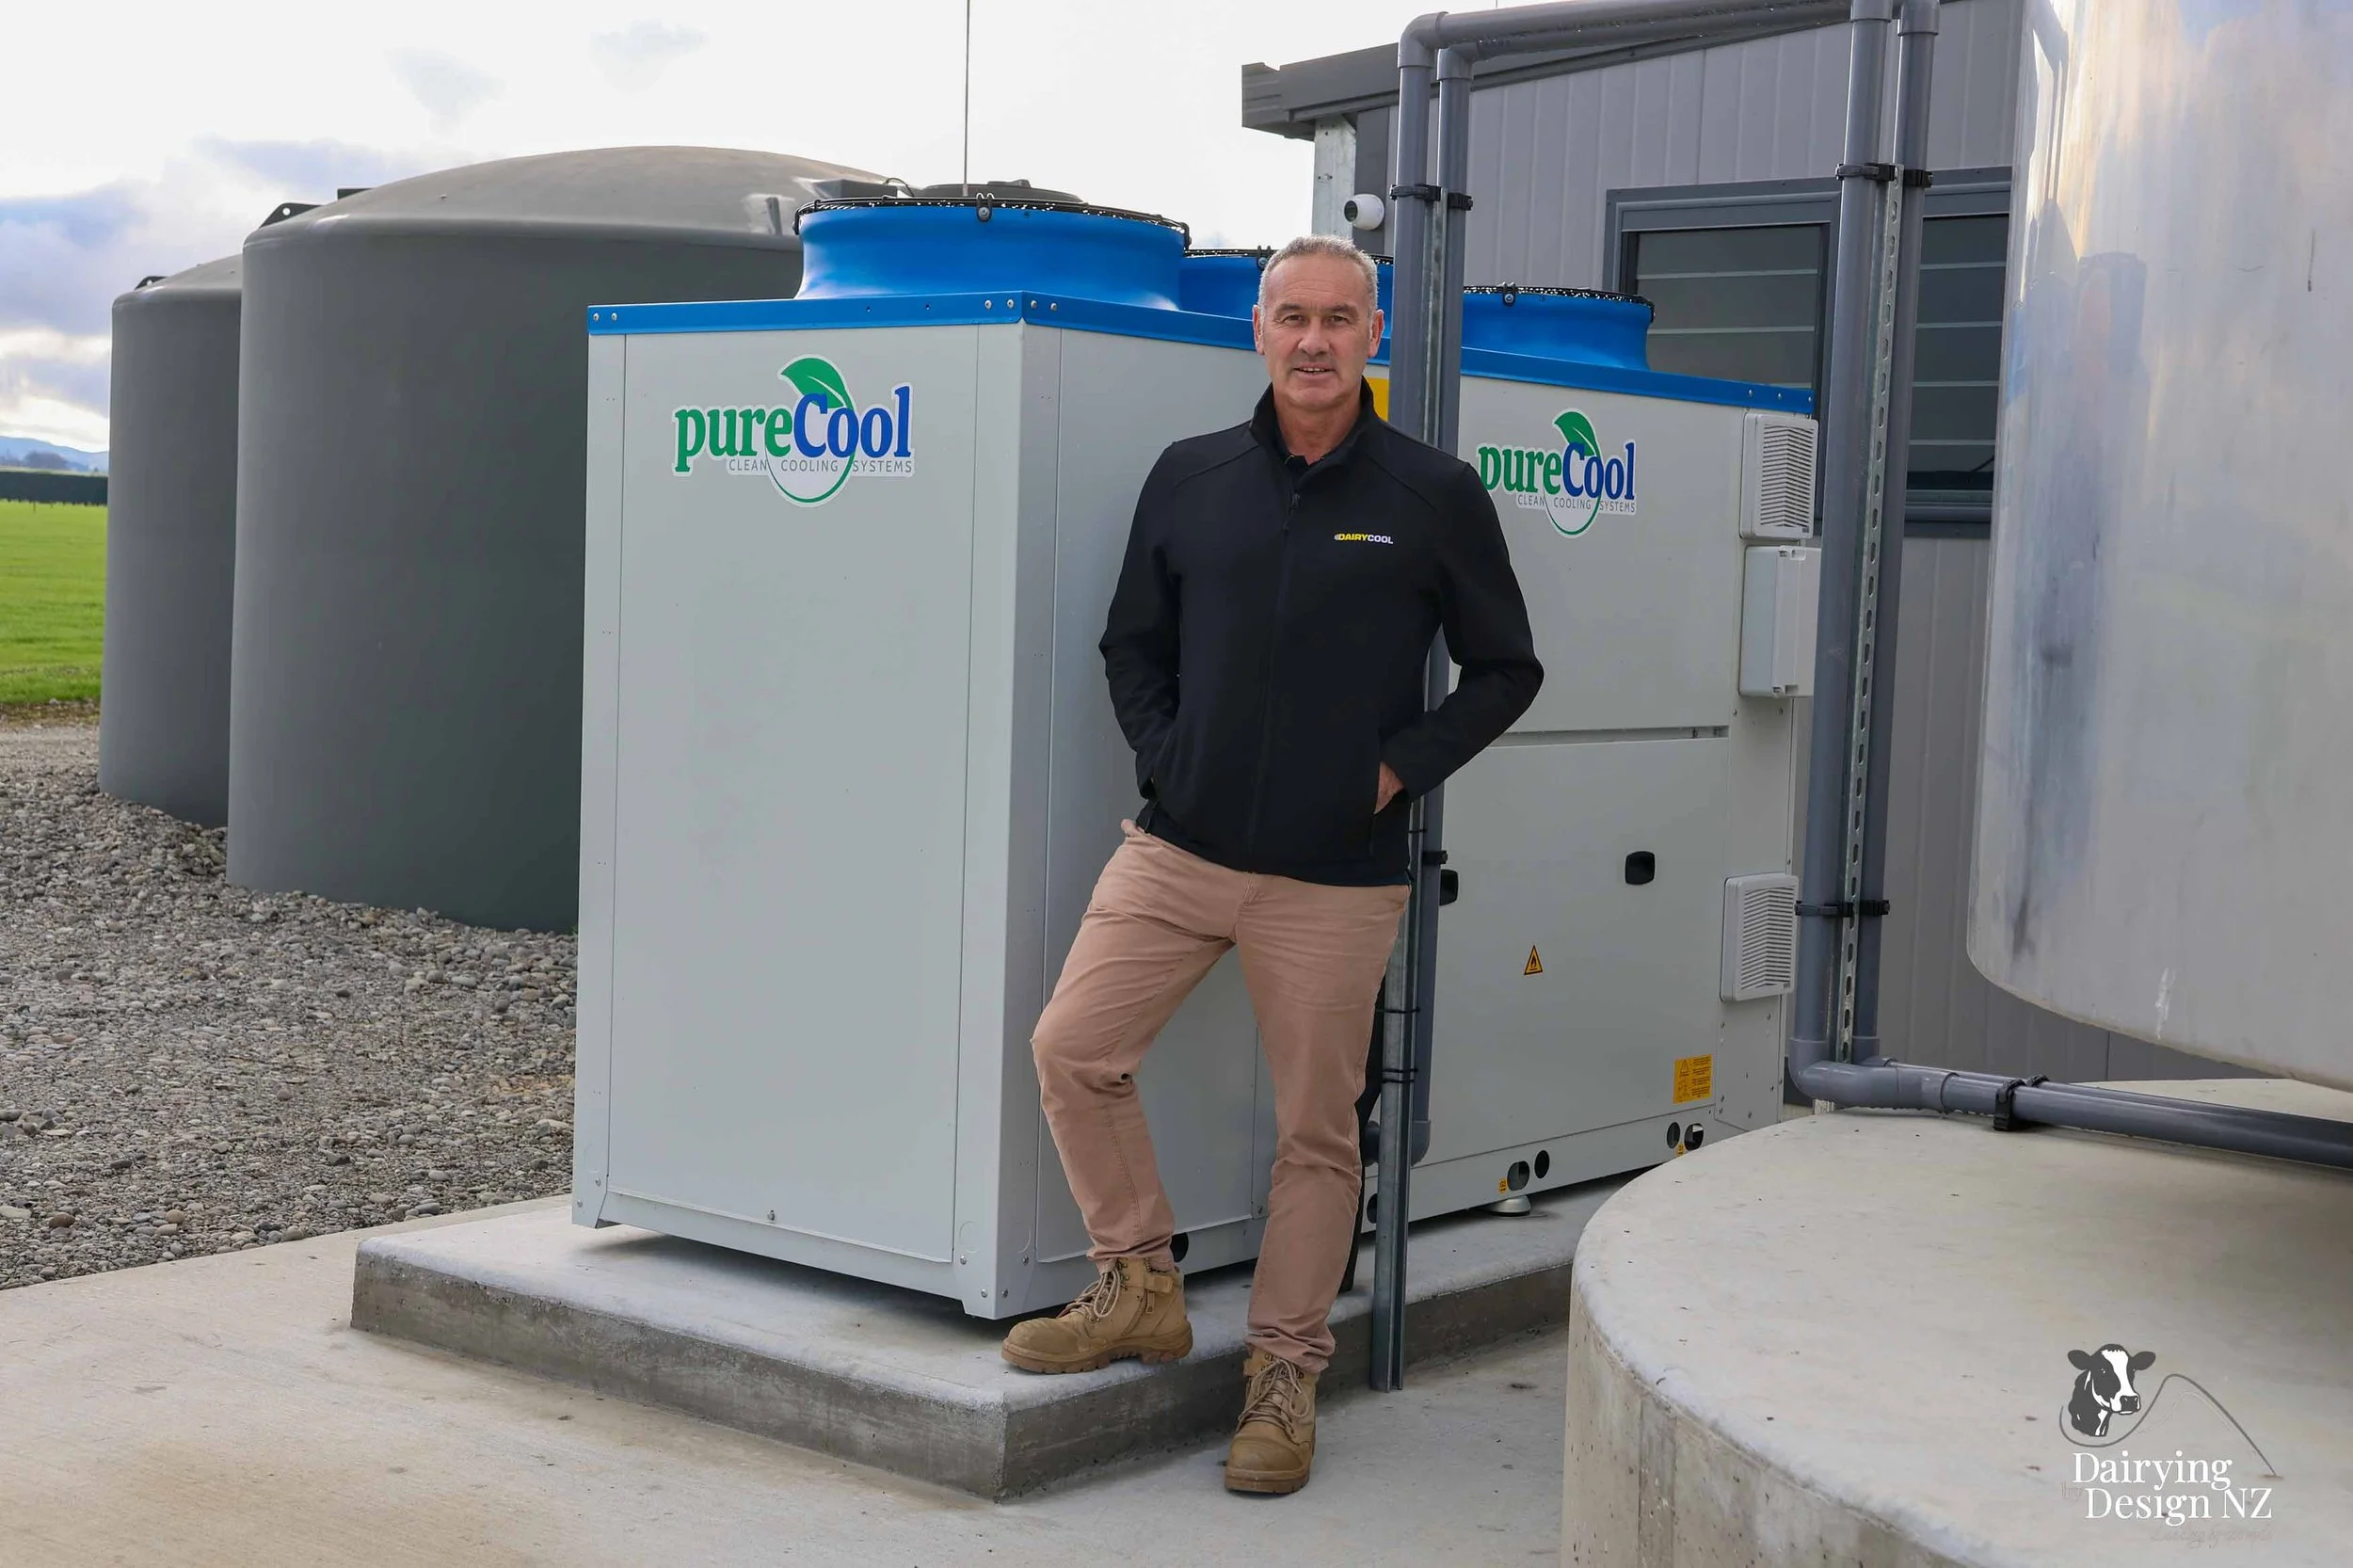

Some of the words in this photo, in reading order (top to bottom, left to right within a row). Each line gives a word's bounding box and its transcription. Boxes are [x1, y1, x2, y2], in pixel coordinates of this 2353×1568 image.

[675, 385, 912, 472] pureCool
[728, 458, 767, 472] CLEAN
[780, 459, 839, 472] COOLING
[852, 459, 912, 472] SYSTEMS
[1517, 494, 1545, 506] CLEAN
[1553, 497, 1592, 509] COOLING
[1599, 500, 1635, 513] SYSTEMS
